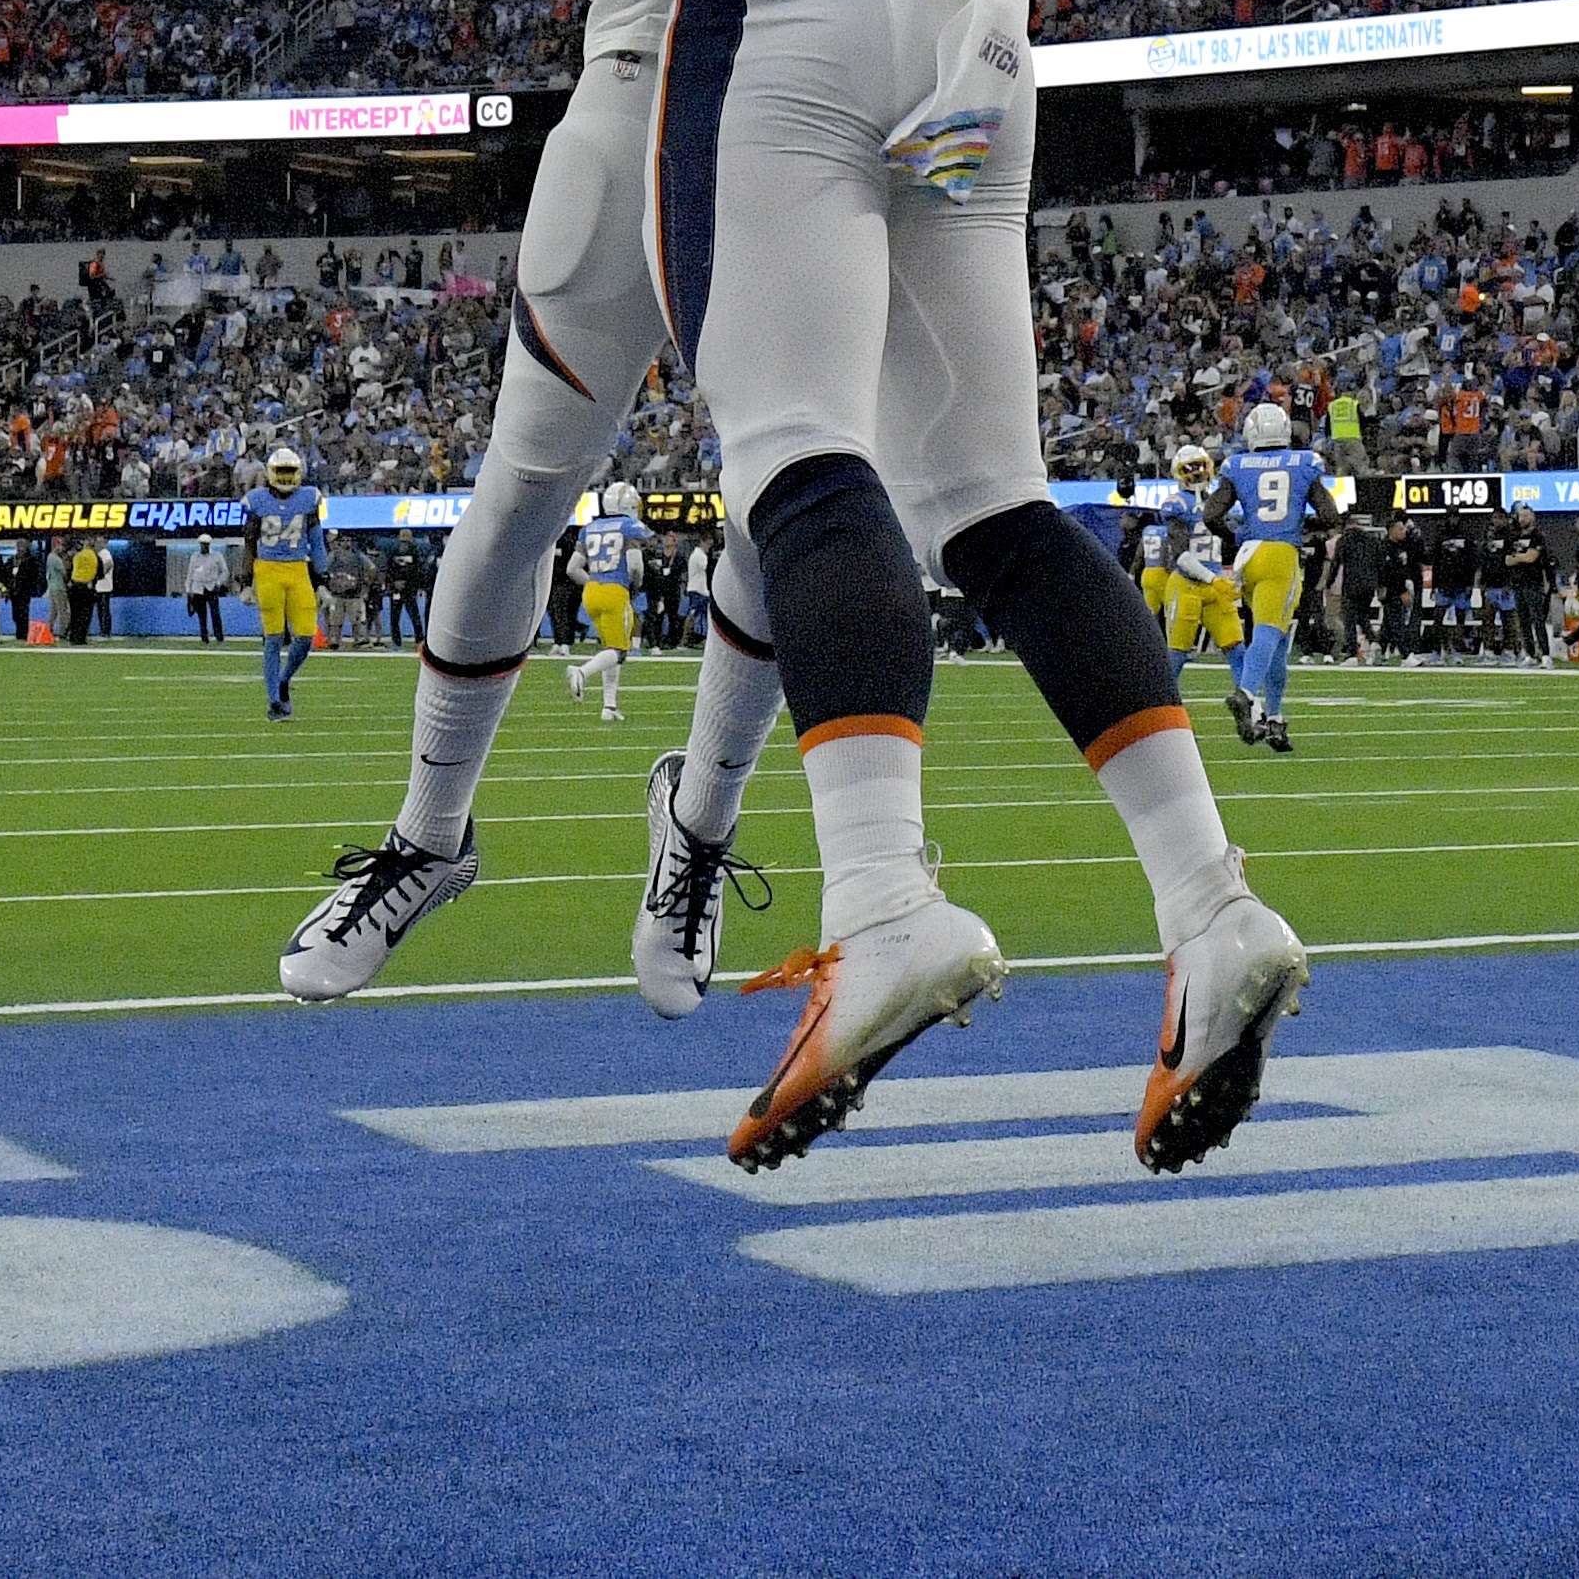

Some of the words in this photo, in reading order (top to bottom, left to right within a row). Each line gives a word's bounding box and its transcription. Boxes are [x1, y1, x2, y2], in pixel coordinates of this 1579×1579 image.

[1177, 40, 1206, 66] ALT
[1210, 37, 1242, 63] 98.7
[1256, 32, 1290, 59] LA'S
[1294, 29, 1330, 56] NEW
[1336, 18, 1443, 53] ALTERNATIVE
[288, 105, 413, 132] INTERCEPT
[480, 101, 509, 123] CC
[1257, 471, 1290, 522] 9
[1408, 486, 1430, 503] Q1
[1441, 480, 1489, 506] 1:49
[128, 501, 249, 532] CHARGE
